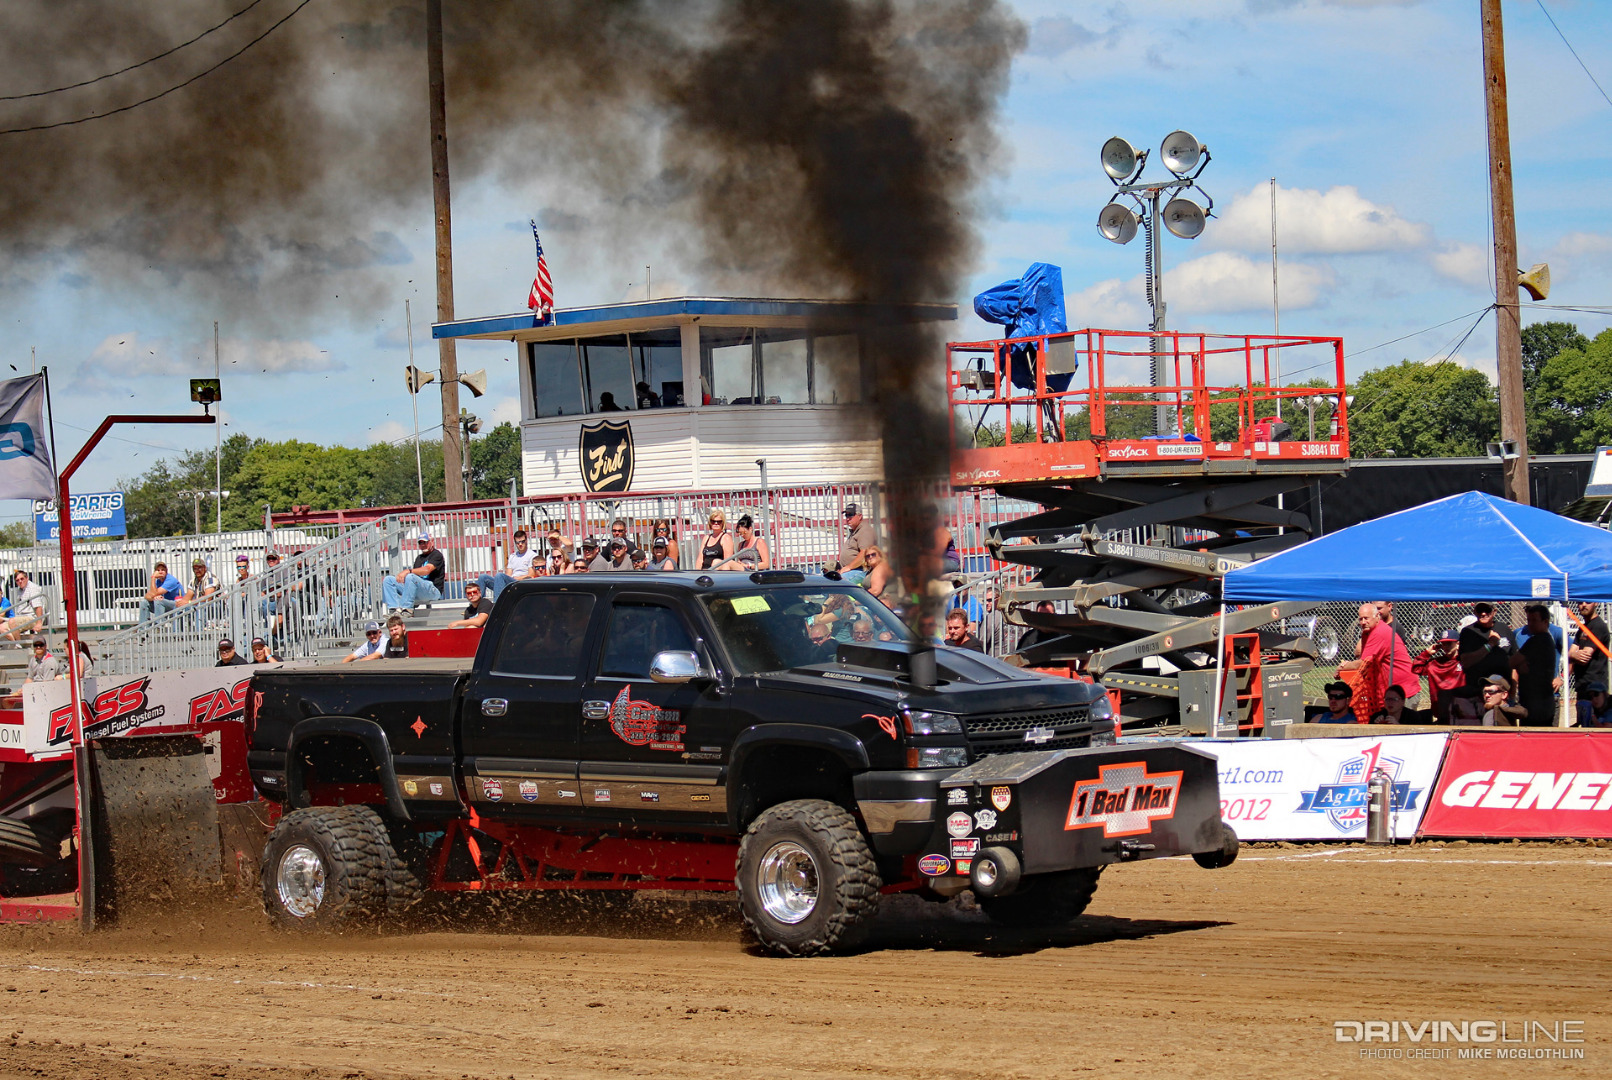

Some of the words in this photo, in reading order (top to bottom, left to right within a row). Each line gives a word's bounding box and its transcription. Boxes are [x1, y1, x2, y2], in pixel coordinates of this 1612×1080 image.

[1109, 445, 1149, 458] SKYJACK
[1158, 446, 1202, 456] 1-800-UR-RENTS
[1301, 443, 1328, 456] SJ8841
[1330, 444, 1340, 456] RT
[590, 438, 628, 482] First
[1107, 542, 1133, 556] SJ8841
[1134, 548, 1160, 560] ROUGH
[1160, 550, 1192, 566] TERRAIN
[1268, 671, 1301, 682] SKYJACK
[189, 676, 251, 724] FAS
[49, 677, 151, 744] FASS
[631, 706, 680, 722] Carlson
[84, 723, 110, 740] Diesel
[111, 718, 129, 733] Fuel
[130, 706, 164, 727] Systems
[1077, 791, 1090, 817] 1
[1090, 786, 1130, 816] Bad
[1131, 784, 1173, 811] Max
[1320, 788, 1345, 806] Ag
[985, 833, 1010, 842] CASE
